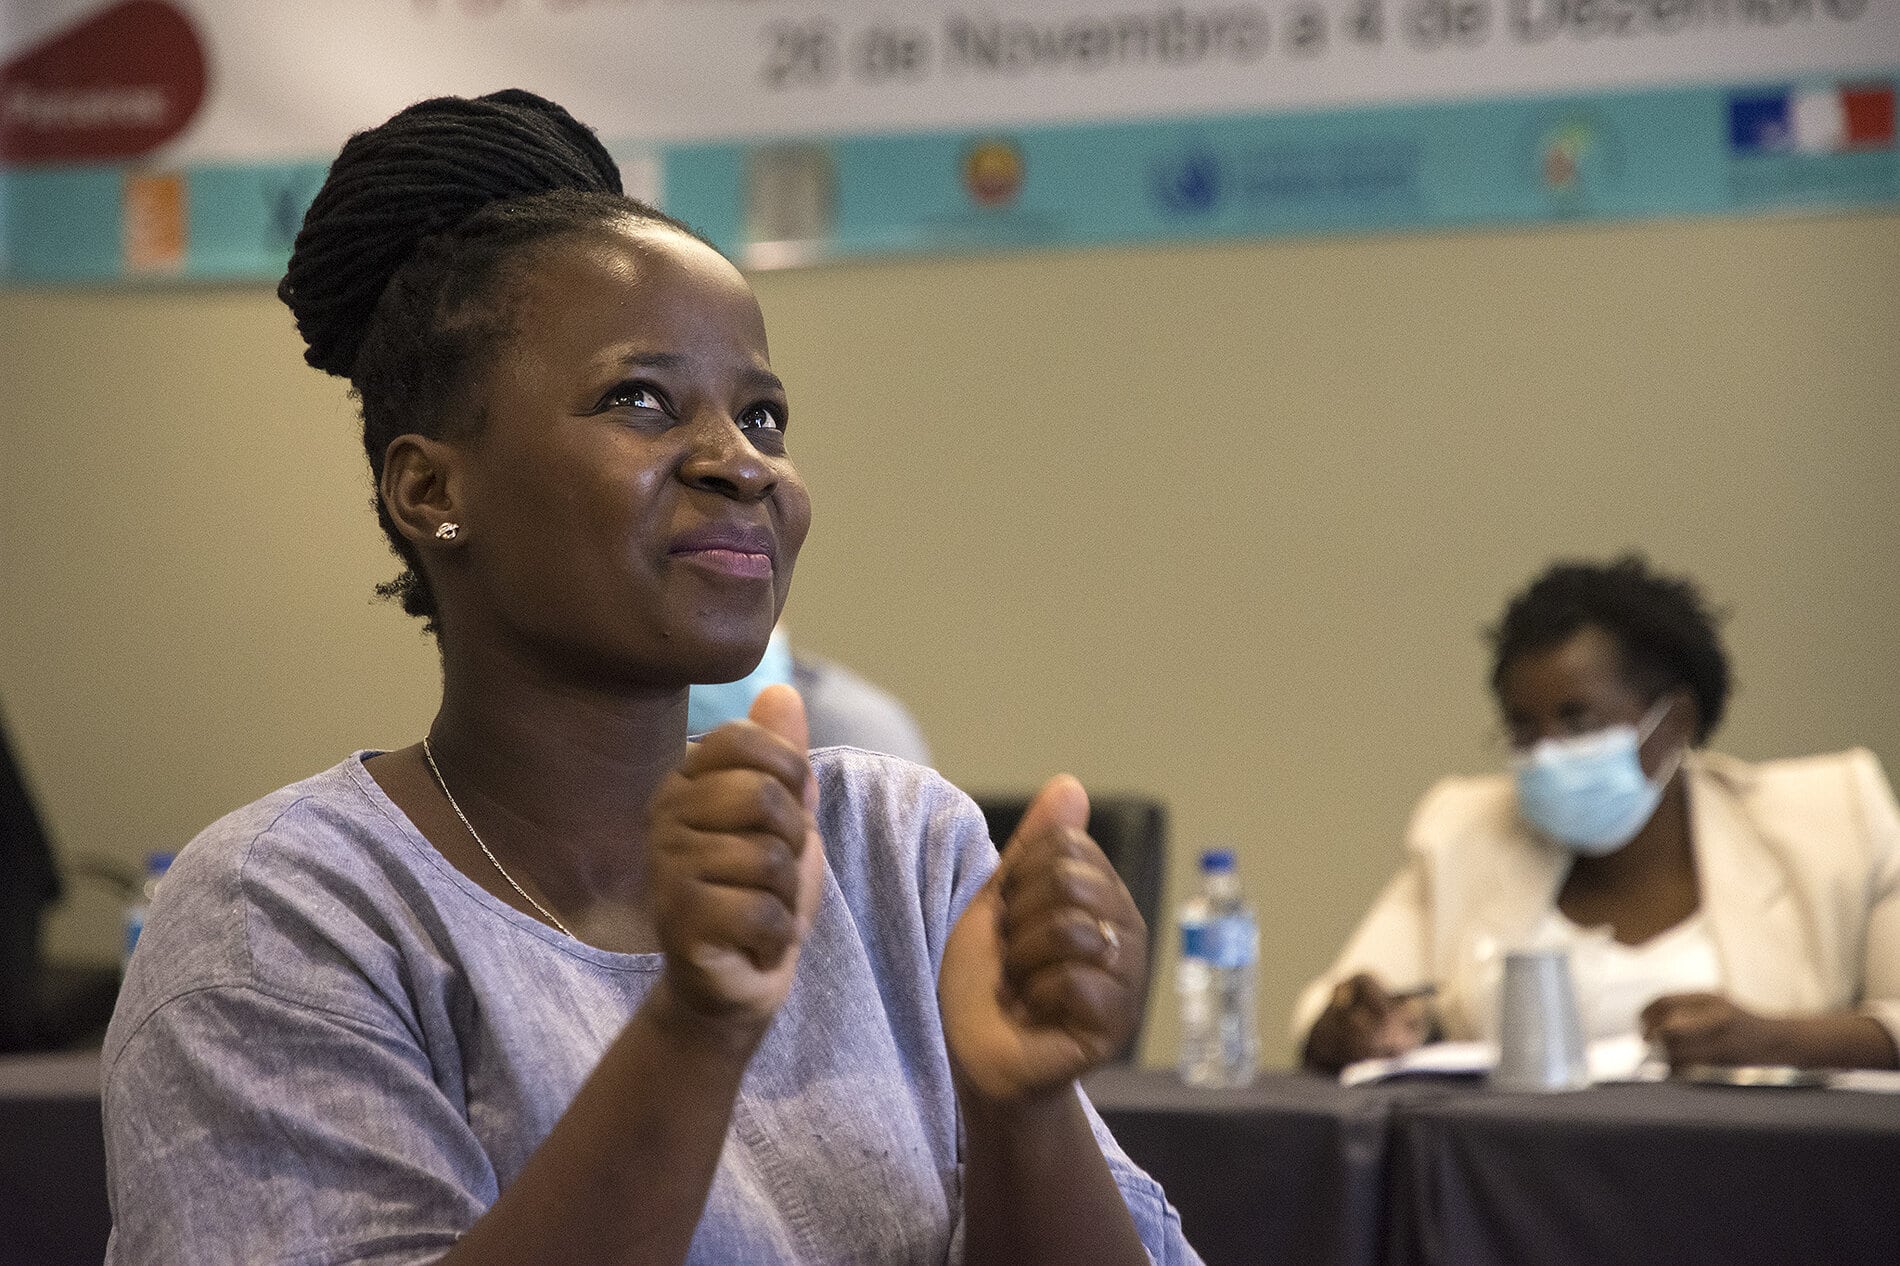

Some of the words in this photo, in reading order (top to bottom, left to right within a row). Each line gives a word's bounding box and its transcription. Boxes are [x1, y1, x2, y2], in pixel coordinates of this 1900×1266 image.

[852, 19, 930, 83] de
[944, 8, 1269, 73] Novembro
[1283, 12, 1326, 58] a
[1404, 0, 1490, 50] de
